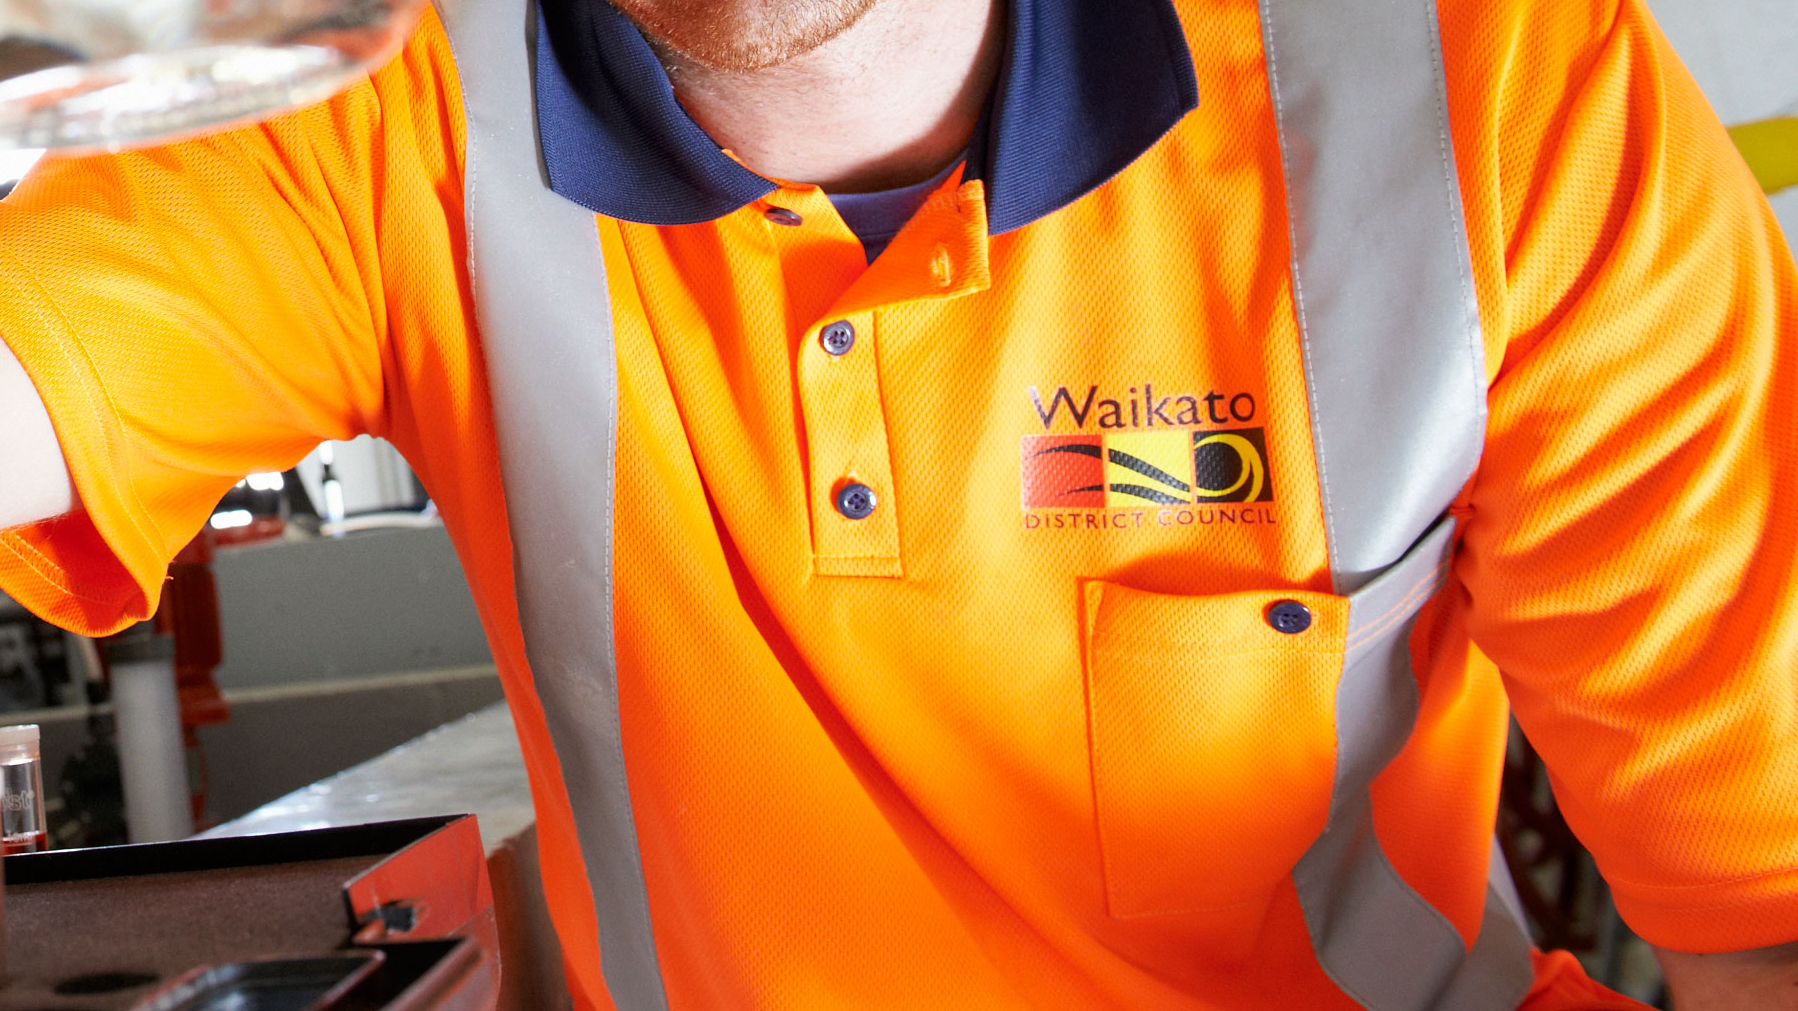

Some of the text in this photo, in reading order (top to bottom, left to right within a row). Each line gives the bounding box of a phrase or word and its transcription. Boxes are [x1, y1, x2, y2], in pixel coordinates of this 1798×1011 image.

[1028, 383, 1256, 429] Waikato
[1024, 507, 1277, 529] DISTRICT COUNCIL
